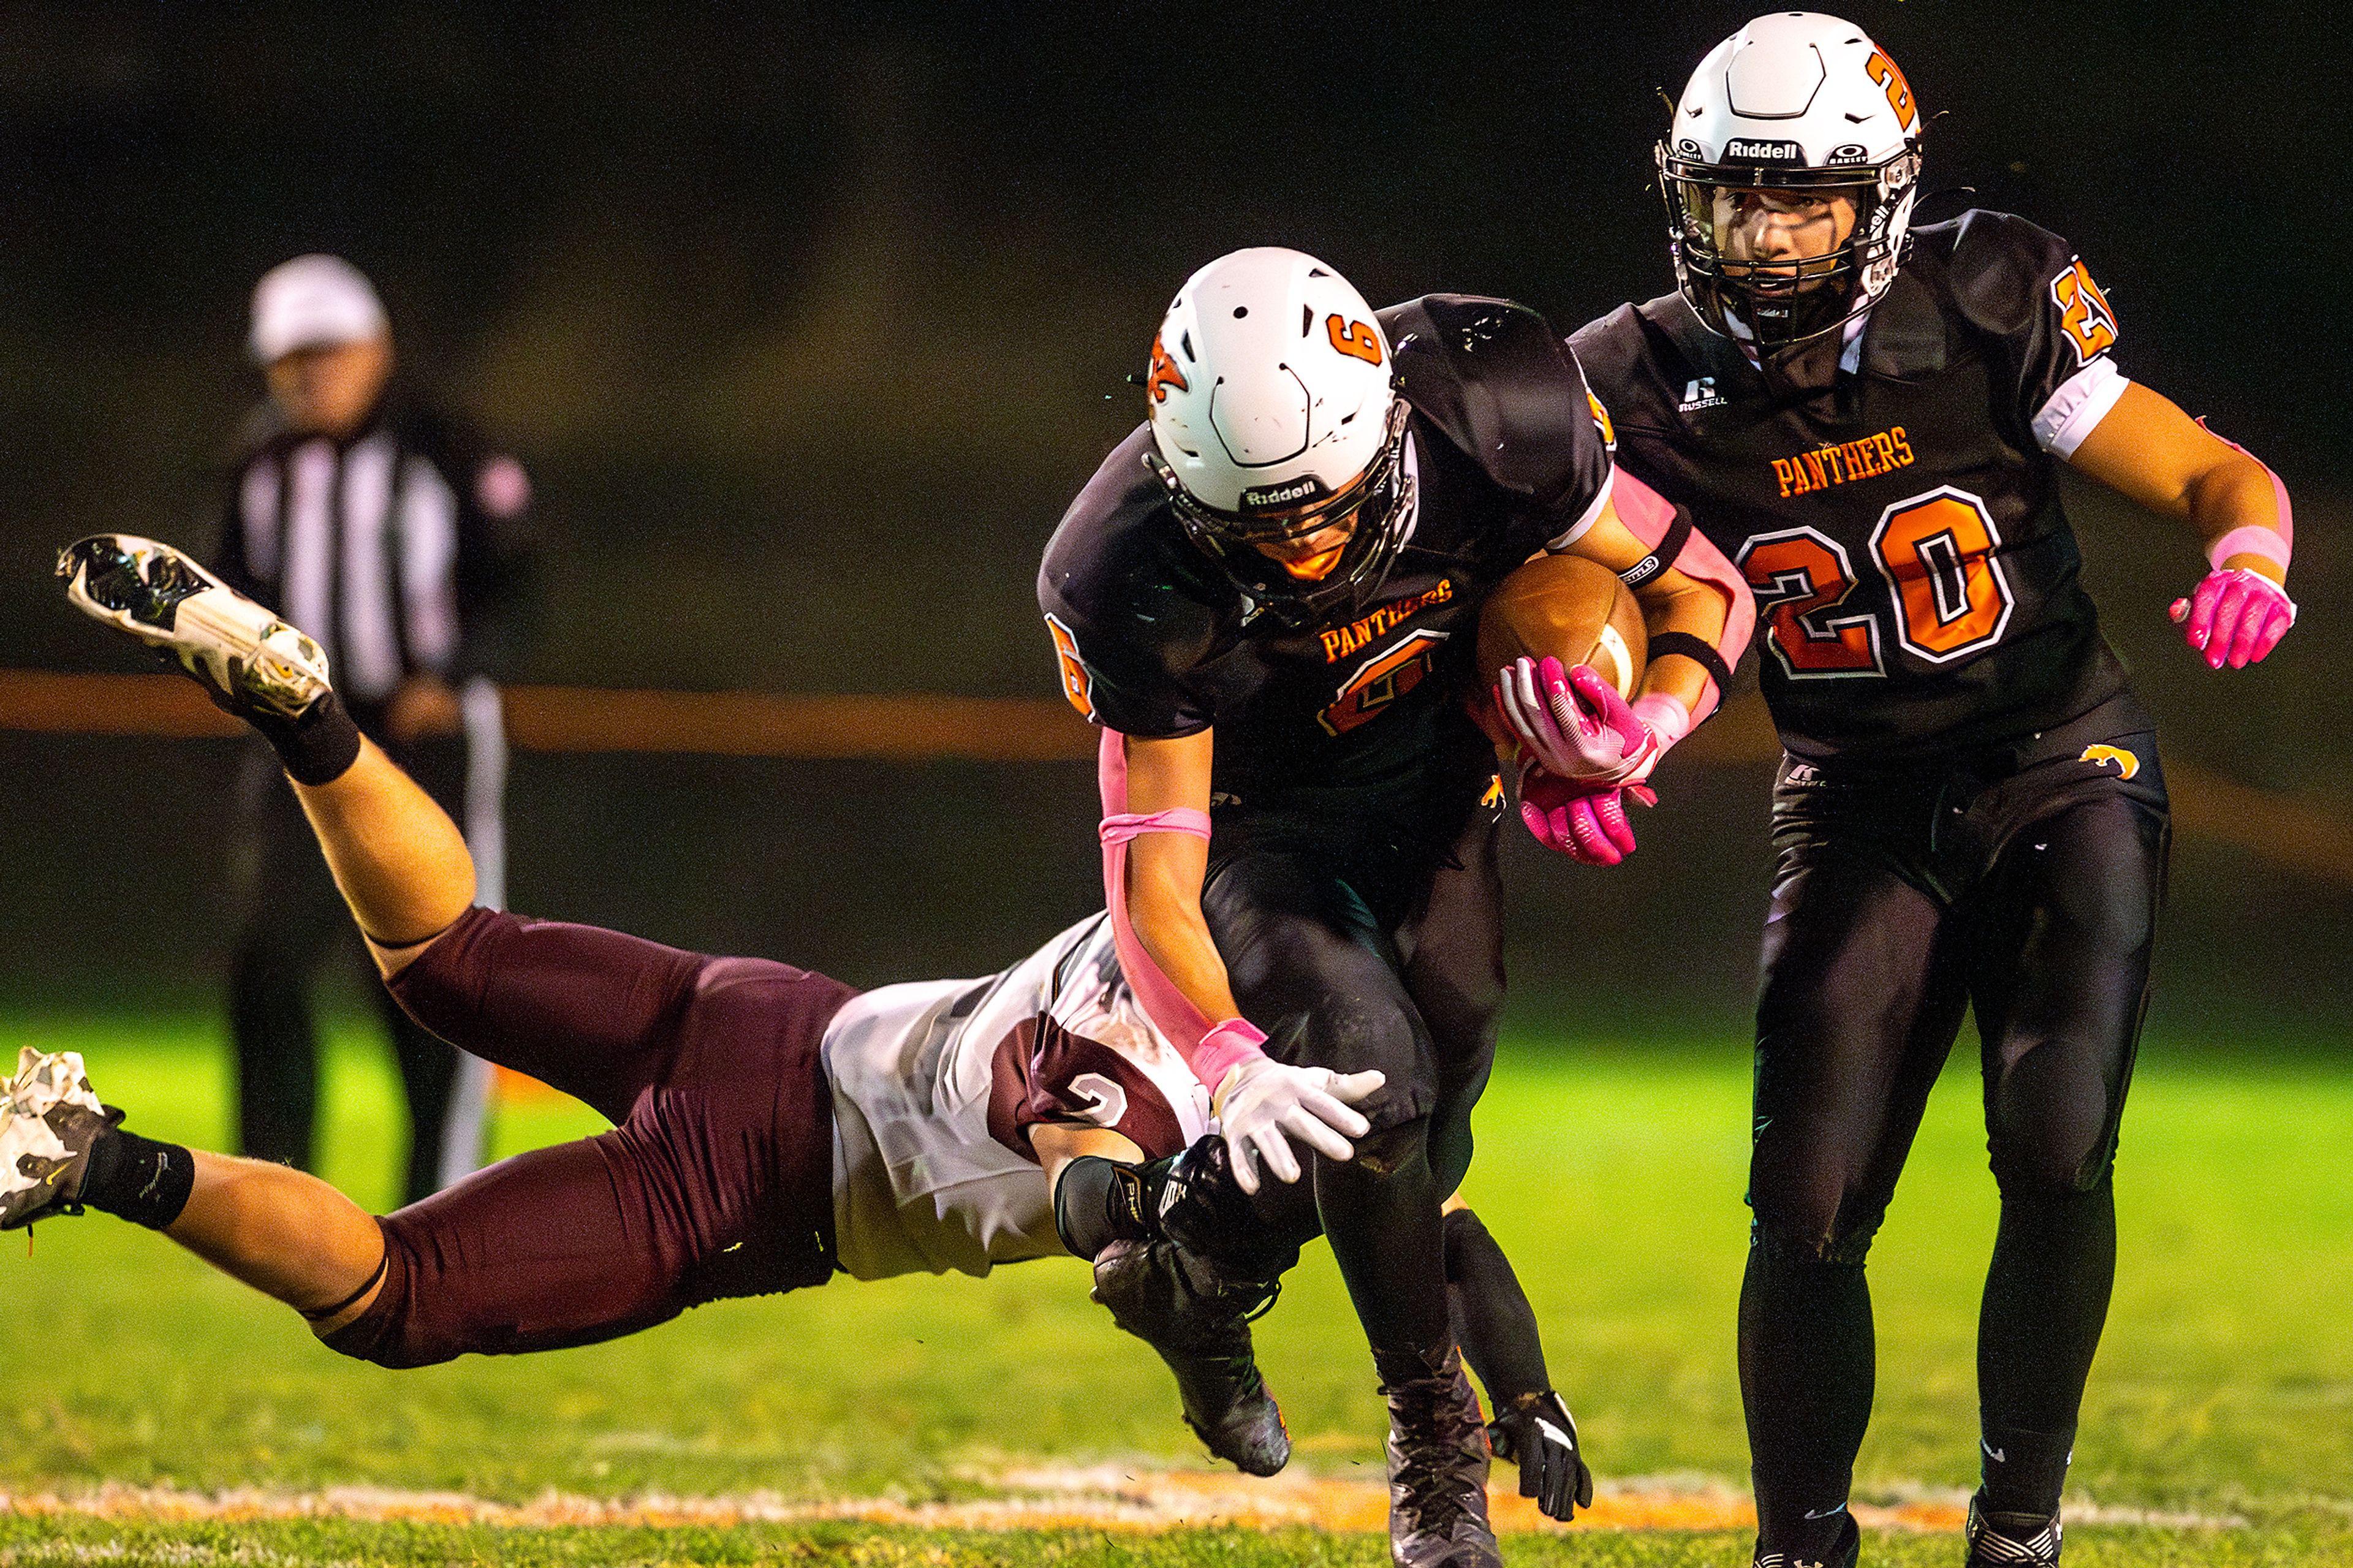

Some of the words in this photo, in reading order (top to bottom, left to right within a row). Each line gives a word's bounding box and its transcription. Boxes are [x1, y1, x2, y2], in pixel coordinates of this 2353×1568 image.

[1865, 42, 1917, 133] 2
[1729, 141, 1797, 159] Riddell
[1325, 313, 1383, 368] 6
[1678, 396, 1728, 413] RUSSELL
[1771, 425, 1915, 498] PANTHERS
[1246, 480, 1316, 506] Riddell
[1735, 484, 2016, 680] 20
